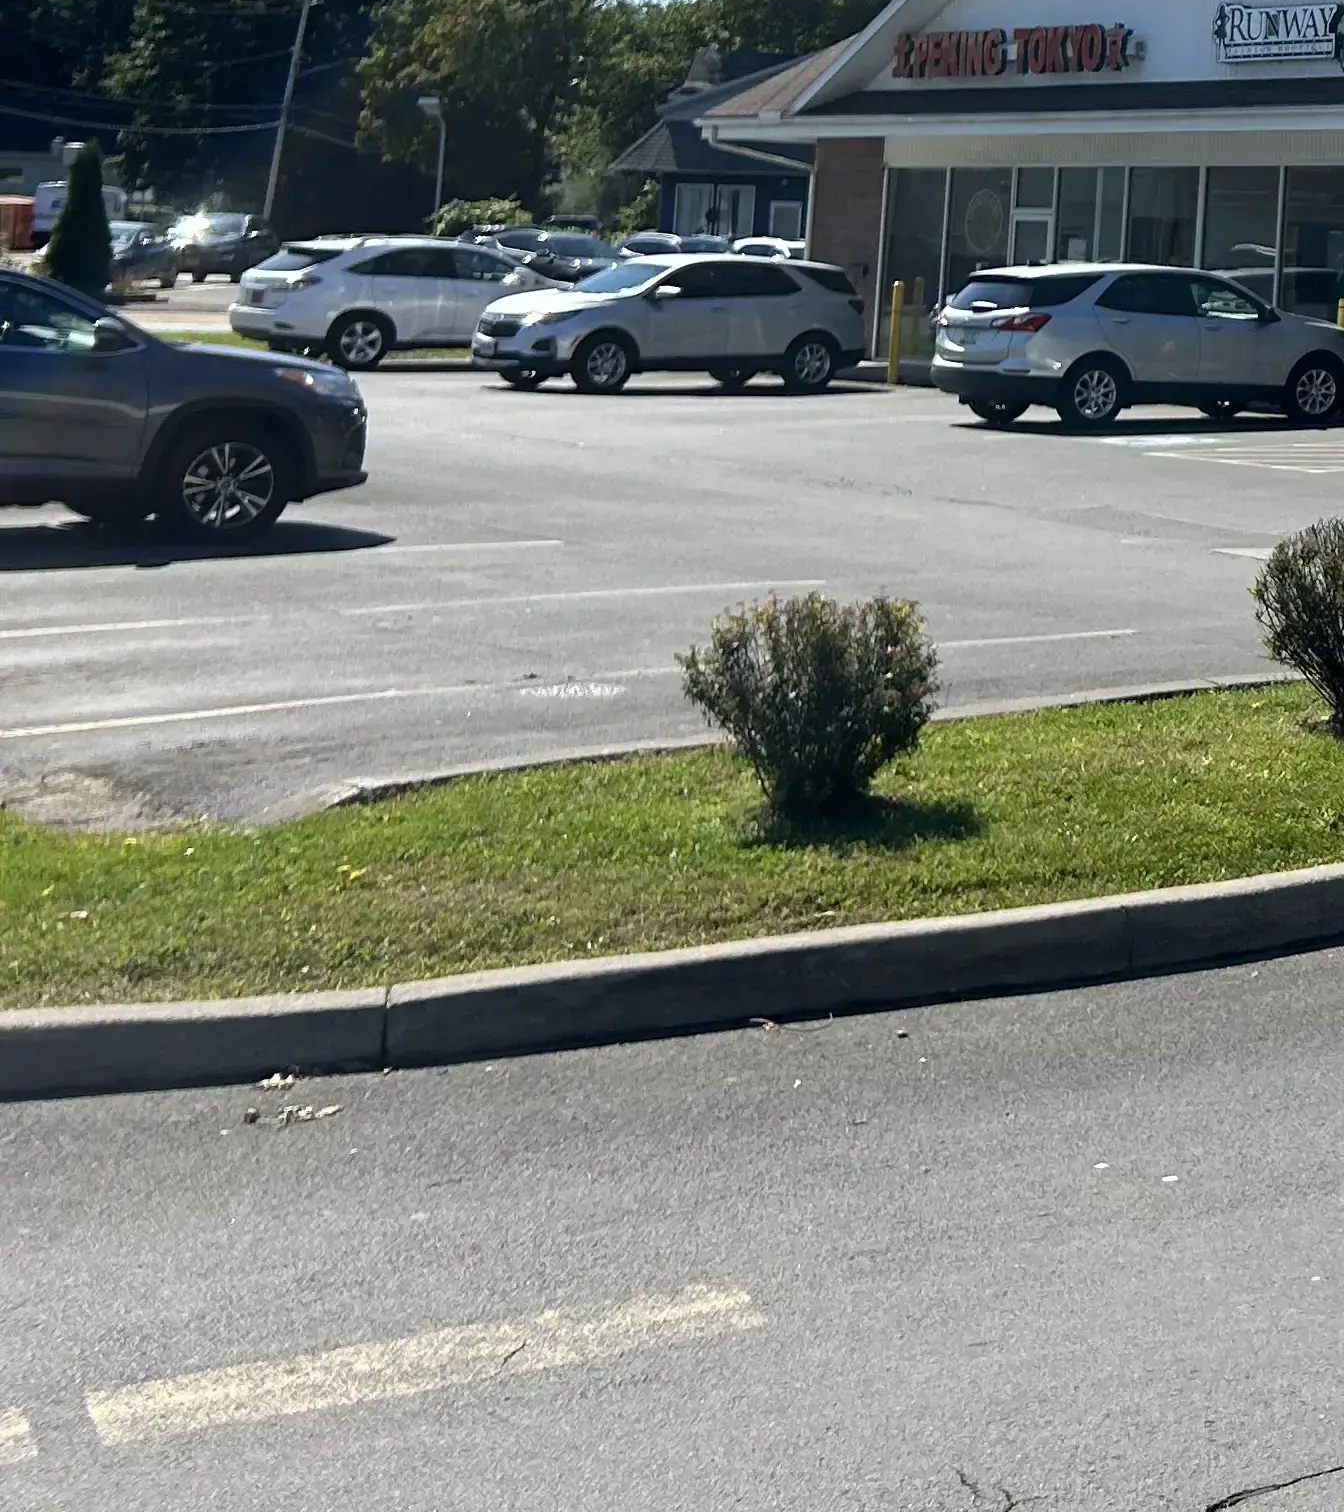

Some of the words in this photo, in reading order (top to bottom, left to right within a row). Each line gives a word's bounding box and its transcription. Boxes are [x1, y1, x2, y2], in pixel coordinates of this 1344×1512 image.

[1229, 7, 1335, 41] RUNWAY
[912, 29, 1004, 78] PEKING
[1013, 24, 1103, 74] TOKYO
